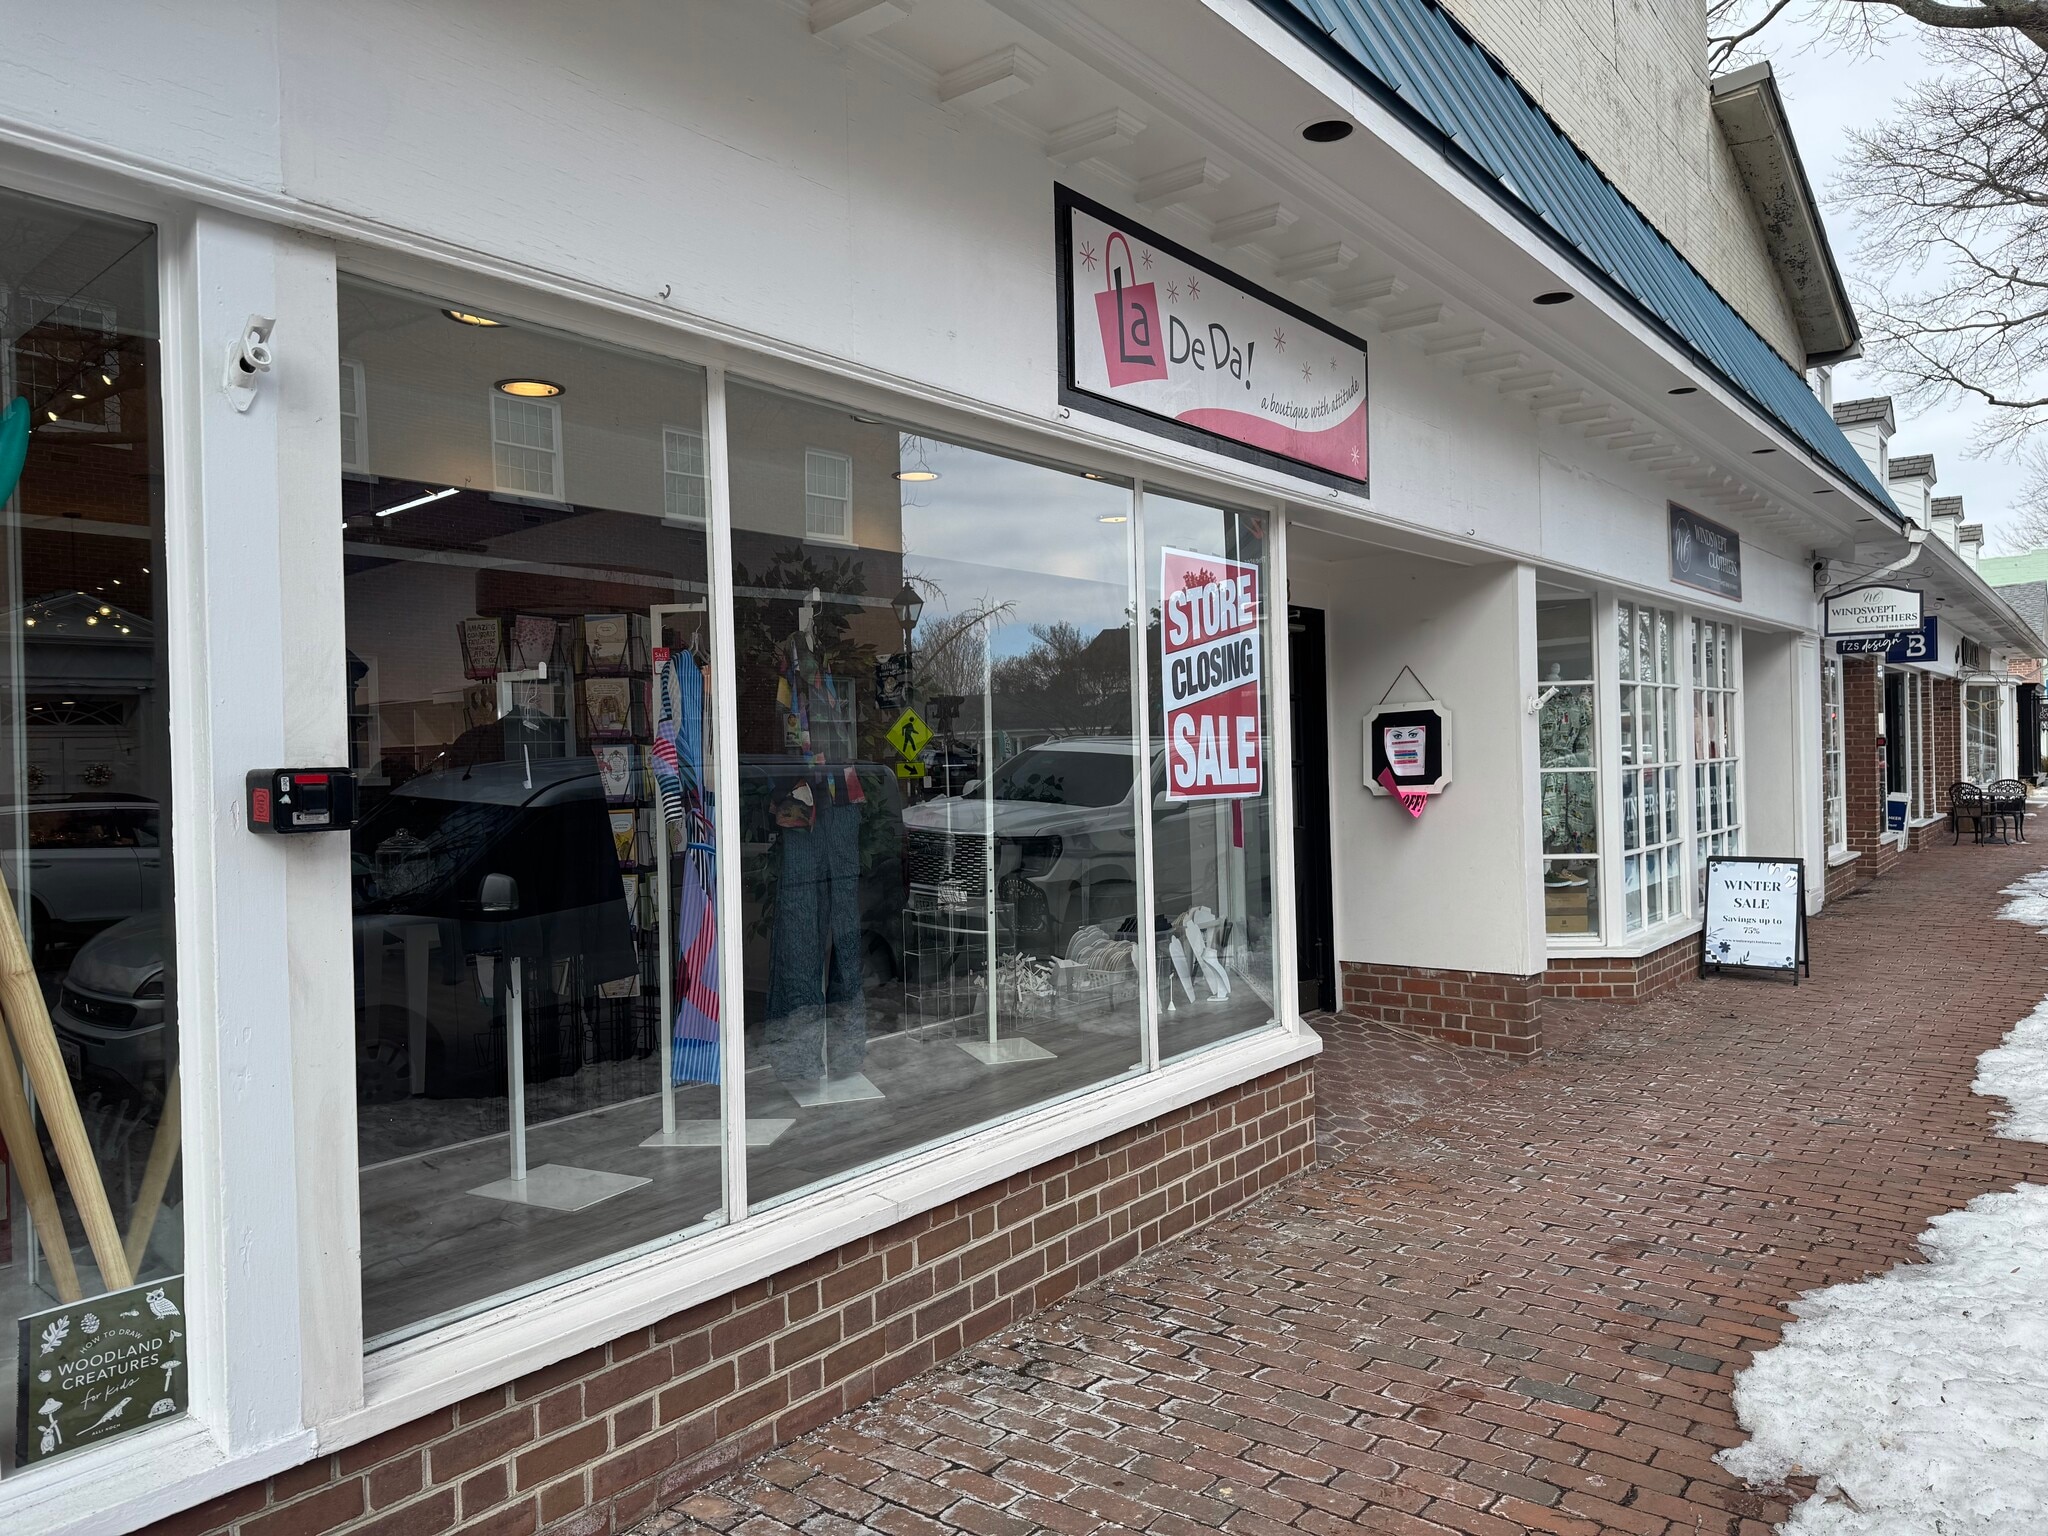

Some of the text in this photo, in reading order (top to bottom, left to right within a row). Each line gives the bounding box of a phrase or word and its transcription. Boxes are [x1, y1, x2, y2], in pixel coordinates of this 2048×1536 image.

[1113, 266, 1156, 366] La
[1261, 376, 1360, 428] a boutique with attitude
[1694, 524, 1727, 553] WINDSWEPT
[1708, 551, 1738, 577] CLOTHIERS
[1168, 574, 1253, 647] STORE
[1831, 604, 1897, 616] WINDSWEPT
[1856, 612, 1918, 624] CLOTHIERS
[1861, 636, 1903, 653] design
[1171, 637, 1254, 701] CLOSING
[1173, 712, 1258, 789] SALE
[1724, 880, 1781, 892] WINTER
[1734, 897, 1770, 909] SALE
[1722, 915, 1782, 926] Savings up to
[1743, 926, 1760, 935] 75%
[80, 1328, 143, 1354] HOW TO DRAW
[58, 1338, 163, 1376] WOODLAND
[62, 1353, 159, 1391] CREATURES
[80, 1377, 140, 1410] for kids
